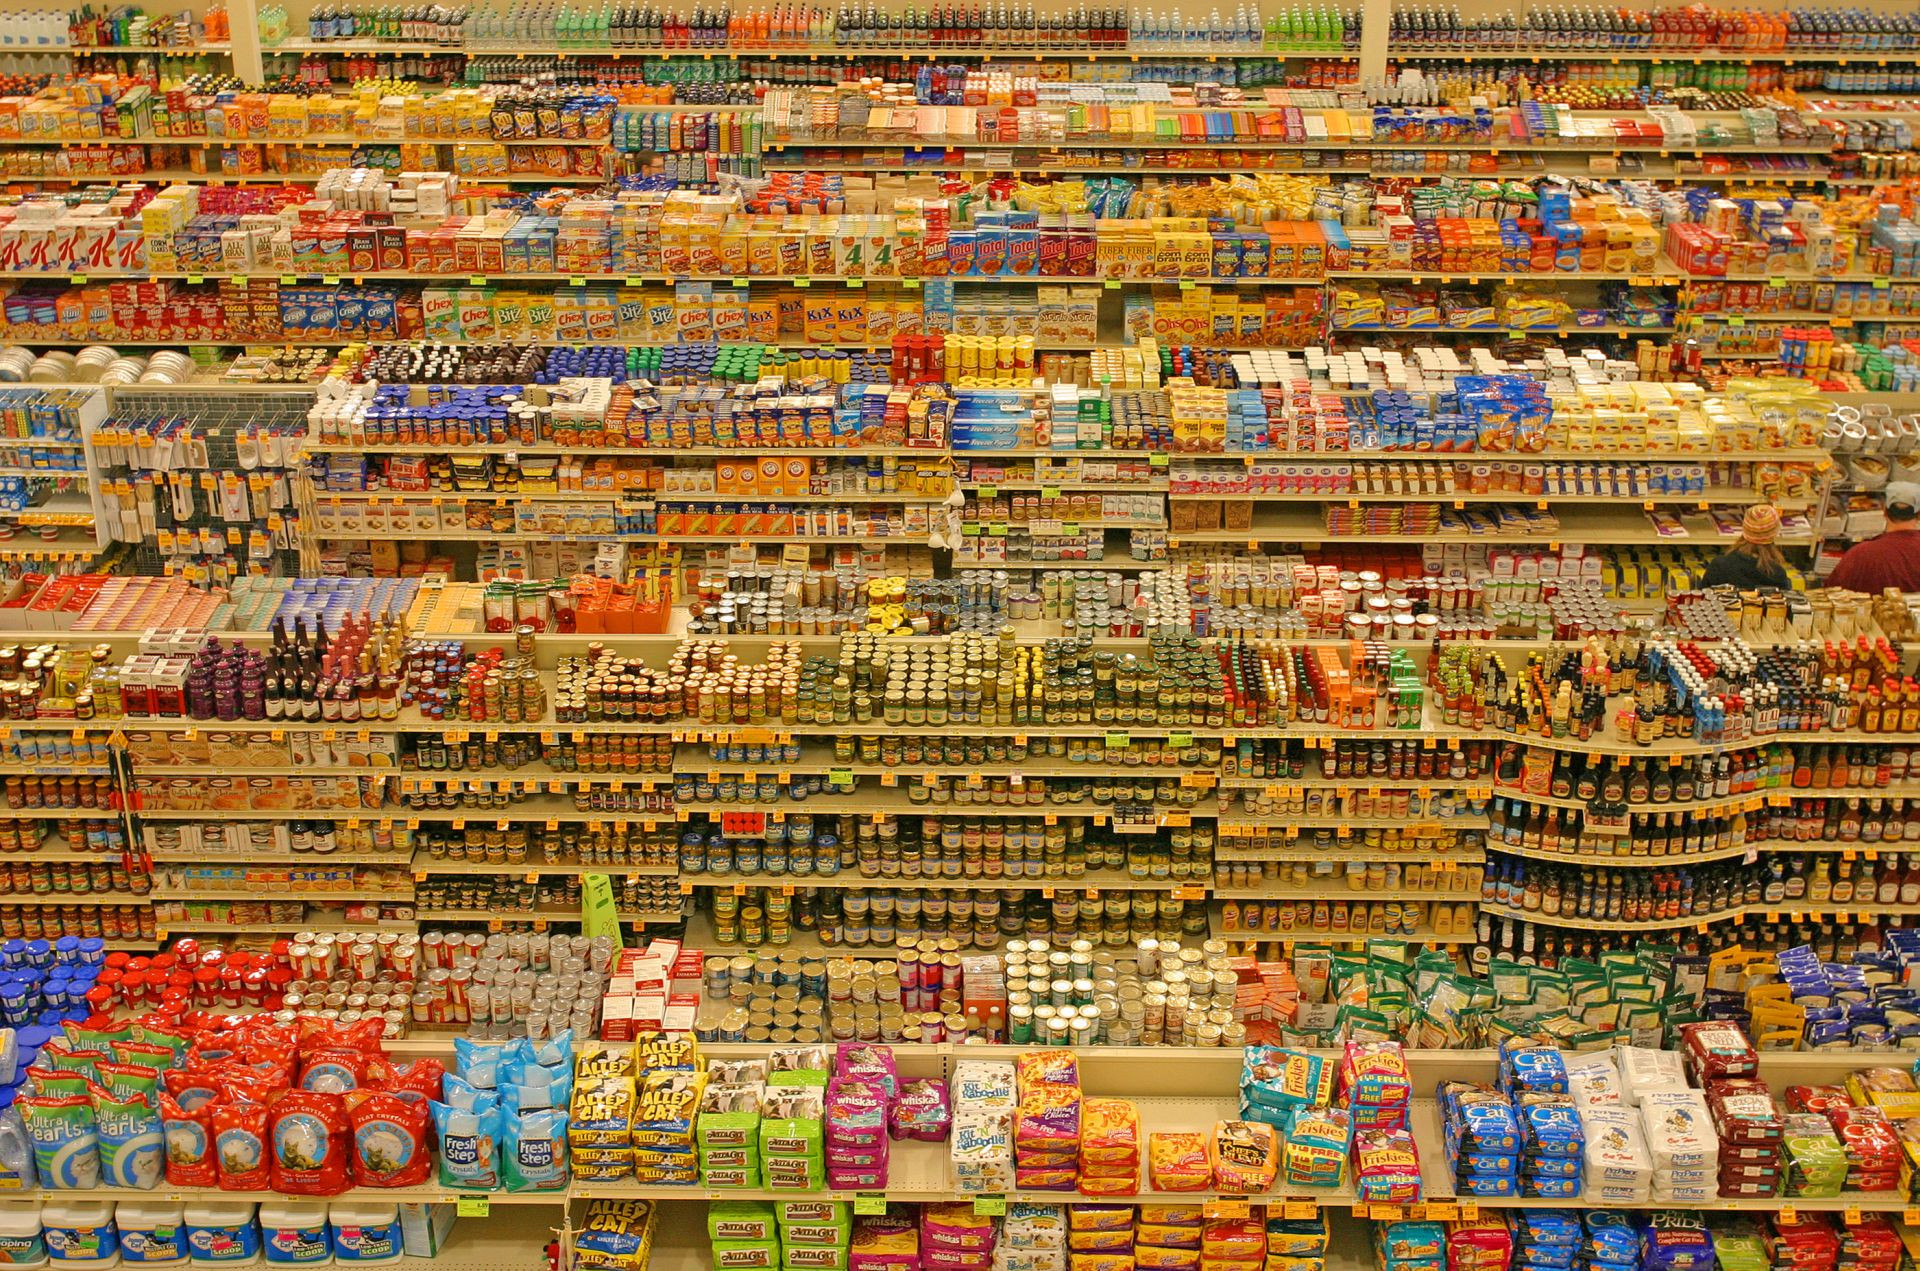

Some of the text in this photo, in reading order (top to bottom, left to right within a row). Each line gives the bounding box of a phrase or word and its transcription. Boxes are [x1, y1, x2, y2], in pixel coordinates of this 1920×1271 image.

[925, 242, 947, 254] Total
[950, 242, 975, 255] Total
[977, 239, 1007, 252] Total
[1009, 239, 1038, 252] Total
[1040, 241, 1067, 254] Total
[1069, 240, 1096, 254] Total
[1099, 245, 1123, 254] FIBER
[225, 249, 245, 257] BRAN
[845, 244, 862, 265] 4
[874, 244, 891, 265] 4
[427, 298, 452, 312] Chex
[462, 308, 489, 322] Chex
[558, 311, 583, 324] Chex
[589, 311, 615, 325] Chex
[680, 311, 709, 324] Chex
[716, 310, 744, 324] Chex
[641, 1041, 688, 1056] ALLEY
[646, 1052, 678, 1068] CAT
[1358, 1058, 1400, 1070] Friskies
[1514, 1051, 1559, 1067] Cat
[582, 1060, 629, 1075] ALLEY
[848, 1064, 887, 1073] whiskas
[1289, 1056, 1303, 1094] Friskies
[962, 1087, 1009, 1098] Kaboodle
[963, 1082, 980, 1091] Kit
[576, 1093, 628, 1109] ALLEY
[642, 1091, 692, 1107] ALLEY
[837, 1097, 877, 1106] whiskas
[901, 1096, 940, 1105] whiskas
[101, 1109, 129, 1121] Ultra
[301, 1106, 332, 1123] CRYSTALS
[579, 1105, 611, 1121] CAT
[643, 1104, 679, 1121] CAT
[1044, 1106, 1078, 1114] Original
[1046, 1112, 1070, 1120] Choice
[1466, 1106, 1508, 1120] Cat
[1531, 1109, 1572, 1123] Cat
[33, 1116, 63, 1128] Ultra
[357, 1113, 410, 1126] FLAT CRYSTALS
[1022, 1118, 1057, 1134] 20% Free
[26, 1121, 83, 1142] Pearls
[959, 1130, 976, 1140] Kit
[1297, 1121, 1344, 1137] Friskies
[1843, 1122, 1883, 1139] Cat
[446, 1137, 477, 1150] Fresh
[575, 1134, 597, 1143] ALLEY
[1789, 1137, 1829, 1152] Cat
[448, 1148, 479, 1162] Step
[520, 1142, 550, 1155] Fresh
[1310, 1148, 1342, 1157] FREE
[521, 1152, 552, 1165] Step
[1363, 1154, 1412, 1165] Friskies
[448, 1164, 477, 1175] Crystals
[589, 1200, 648, 1218] ALLEY
[1011, 1206, 1058, 1217] Kaboodle
[590, 1214, 634, 1234] CAT
[862, 1218, 912, 1227] whiskas
[1586, 1211, 1629, 1226] Cat
[1649, 1214, 1706, 1228] PRIDE
[932, 1234, 959, 1243] whiskas
[1714, 1238, 1753, 1251] Cat
[295, 1249, 323, 1257] SCOOP
[361, 1246, 390, 1255] SCOOP
[931, 1253, 959, 1261] whiskas
